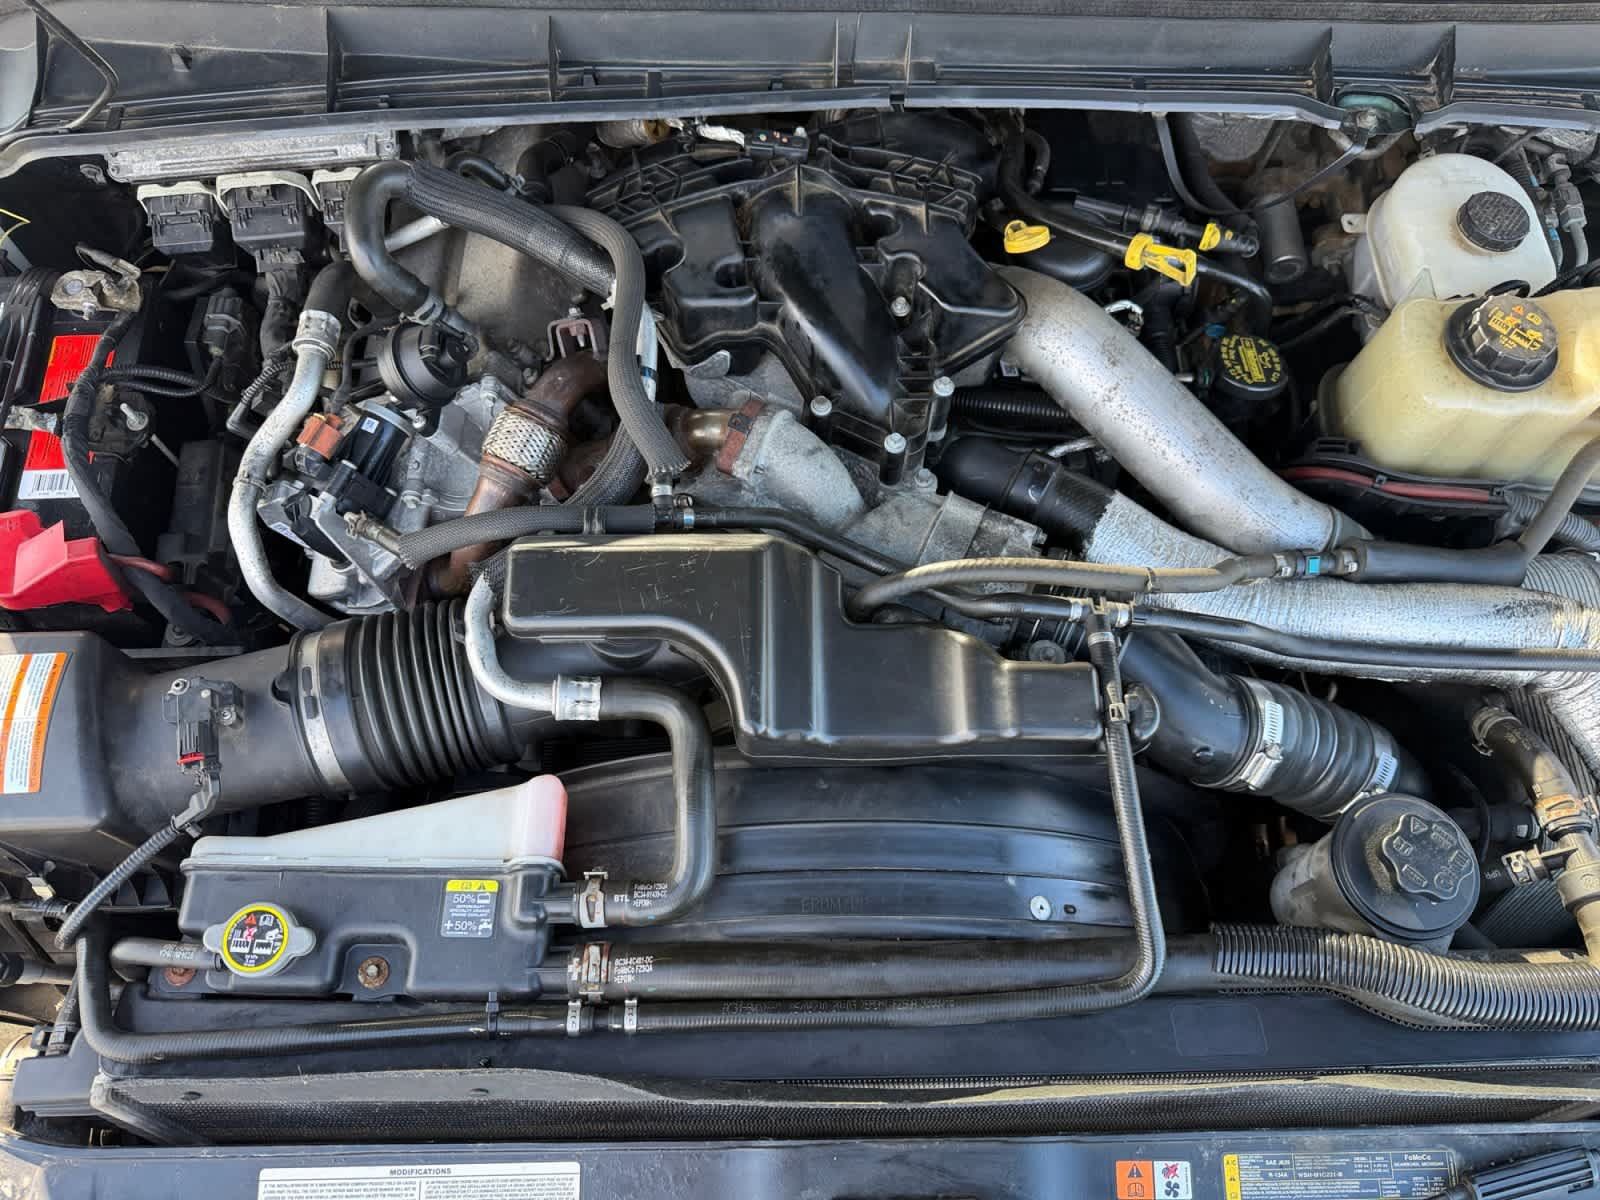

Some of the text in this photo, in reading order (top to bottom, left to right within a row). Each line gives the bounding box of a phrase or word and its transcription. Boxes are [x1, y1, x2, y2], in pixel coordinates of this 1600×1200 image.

[452, 893, 476, 904] 50%
[613, 894, 631, 903] BTL
[1404, 1153, 1432, 1161] FoMoCo
[389, 1168, 452, 1177] MODIFICATIONS
